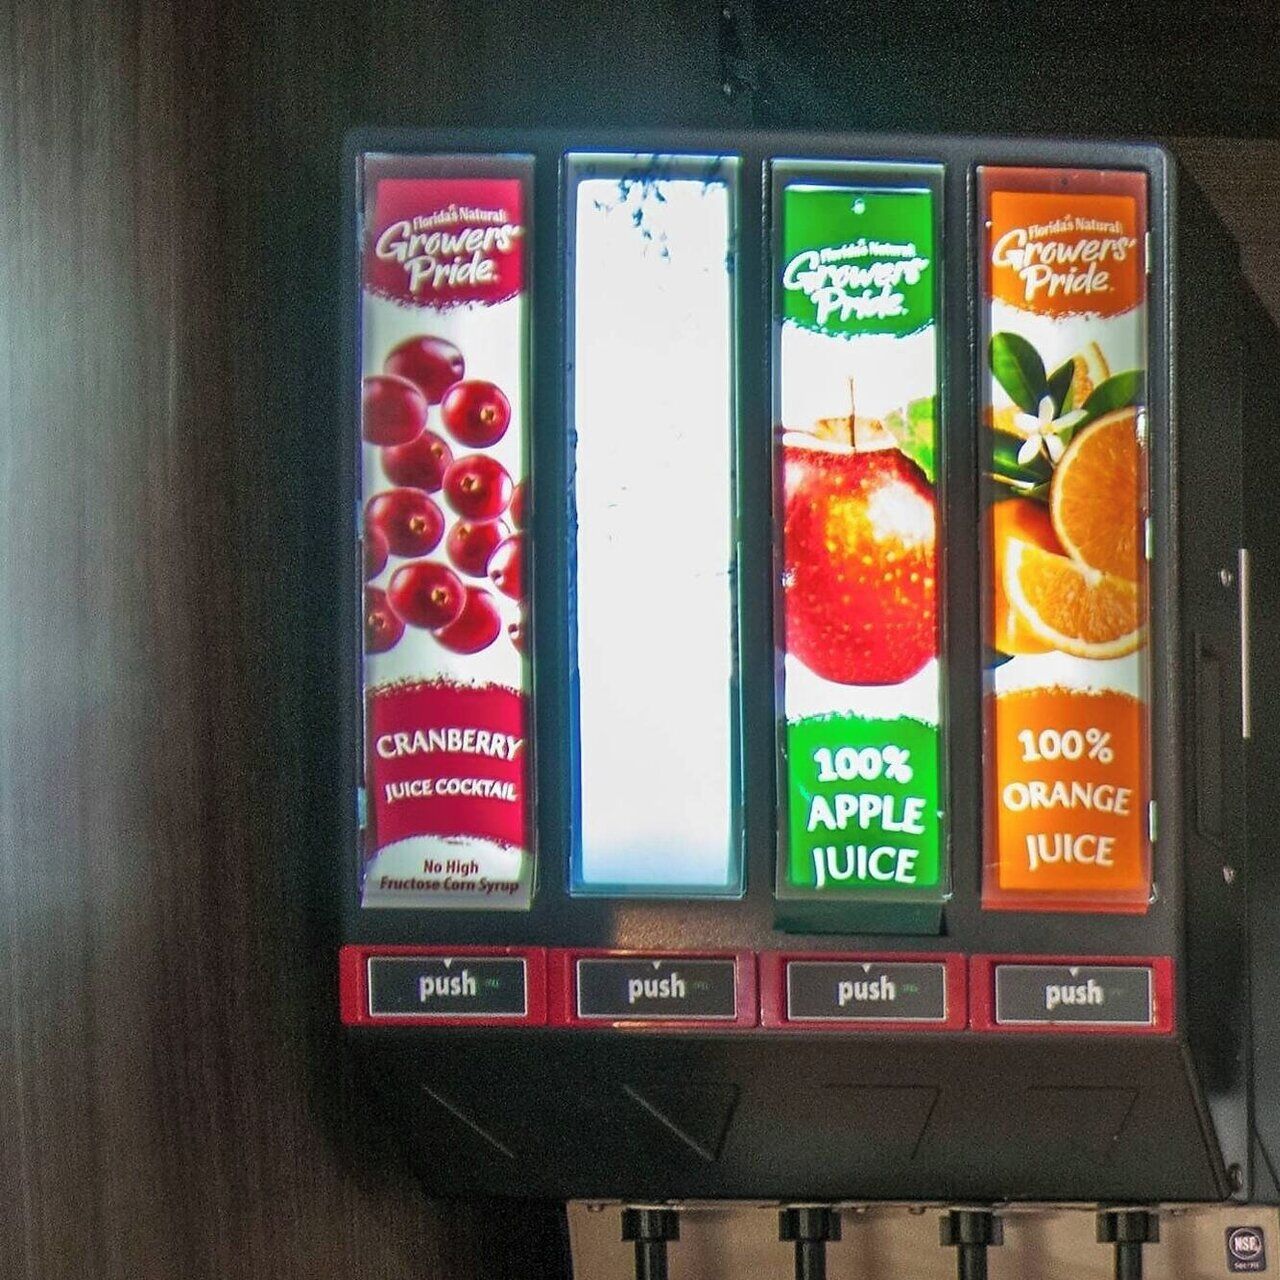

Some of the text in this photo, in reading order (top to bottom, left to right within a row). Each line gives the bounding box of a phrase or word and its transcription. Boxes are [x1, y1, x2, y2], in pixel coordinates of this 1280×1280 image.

[376, 728, 524, 761] CRANBERRY
[1018, 727, 1115, 764] 100%
[814, 745, 913, 784] 100%
[385, 778, 519, 804] JUICE COCKTAIL
[1002, 780, 1133, 816] ORANGE
[807, 793, 927, 835] APPLE
[424, 859, 479, 877] No High
[812, 845, 920, 890] JUICE
[1026, 832, 1117, 872] JUICE
[380, 876, 519, 894] Fructose Corn Syrup
[419, 968, 477, 1002] push
[628, 971, 686, 1004] push
[838, 975, 896, 1007] push
[1046, 978, 1104, 1010] push
